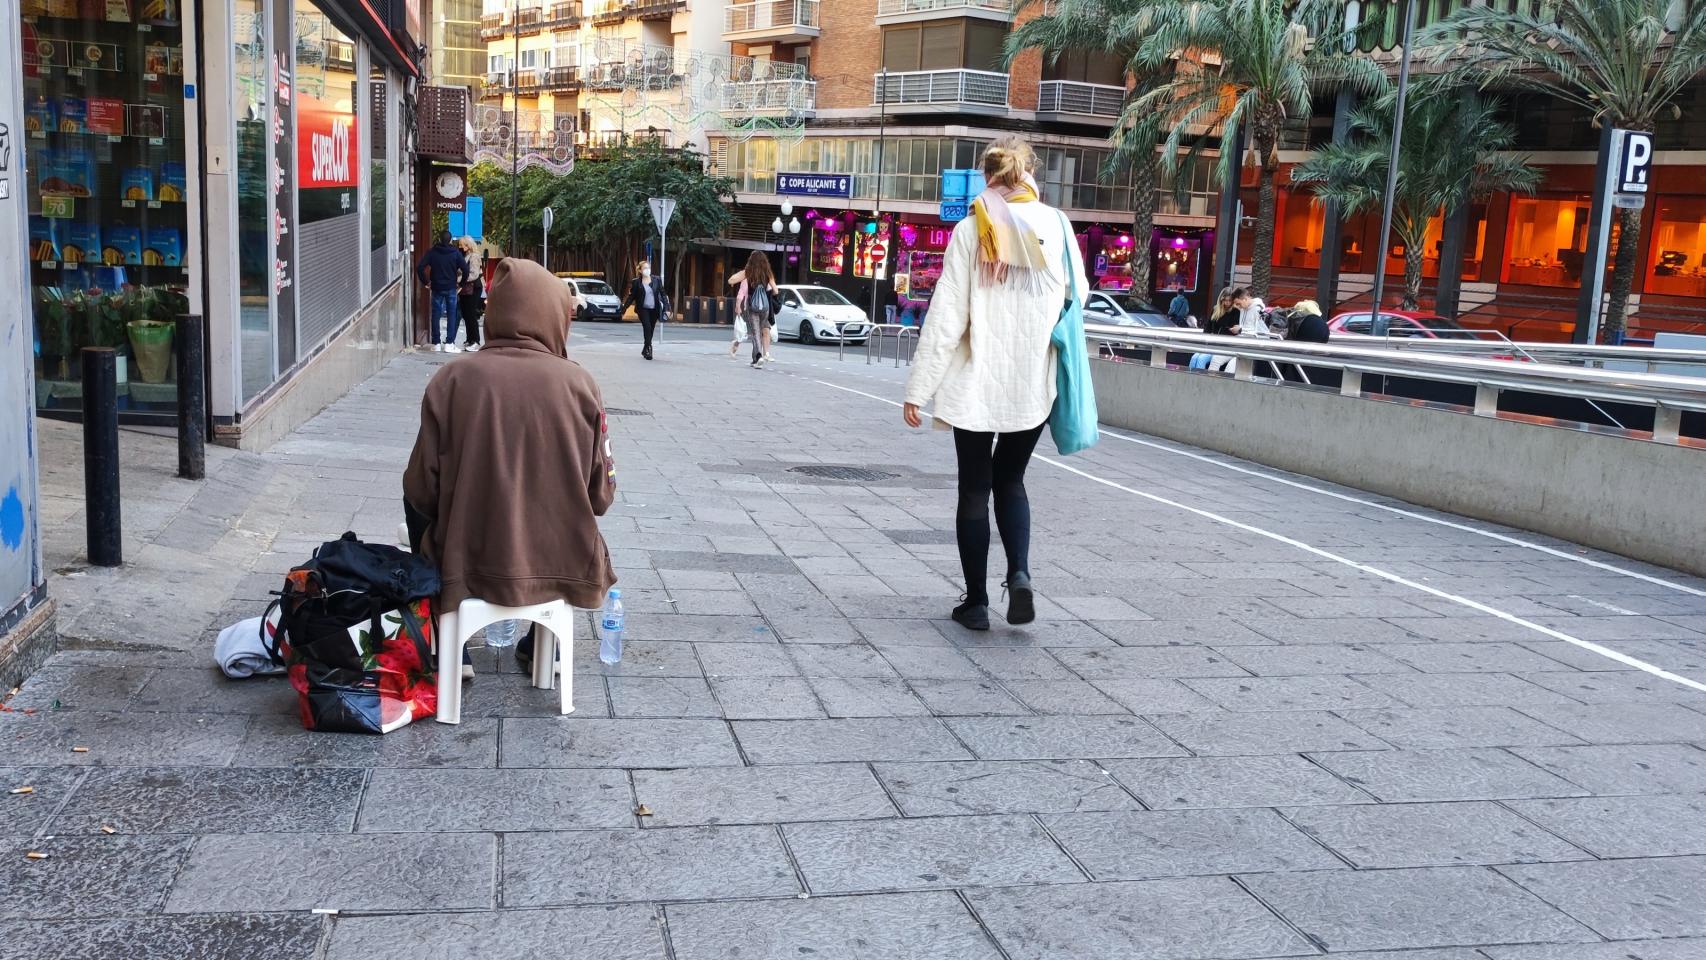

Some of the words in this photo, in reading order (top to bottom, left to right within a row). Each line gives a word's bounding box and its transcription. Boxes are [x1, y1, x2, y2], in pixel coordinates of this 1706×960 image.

[1626, 134, 1651, 182] P
[788, 178, 805, 188] COPE
[805, 179, 837, 189] ALICANTE
[930, 230, 943, 245] LA
